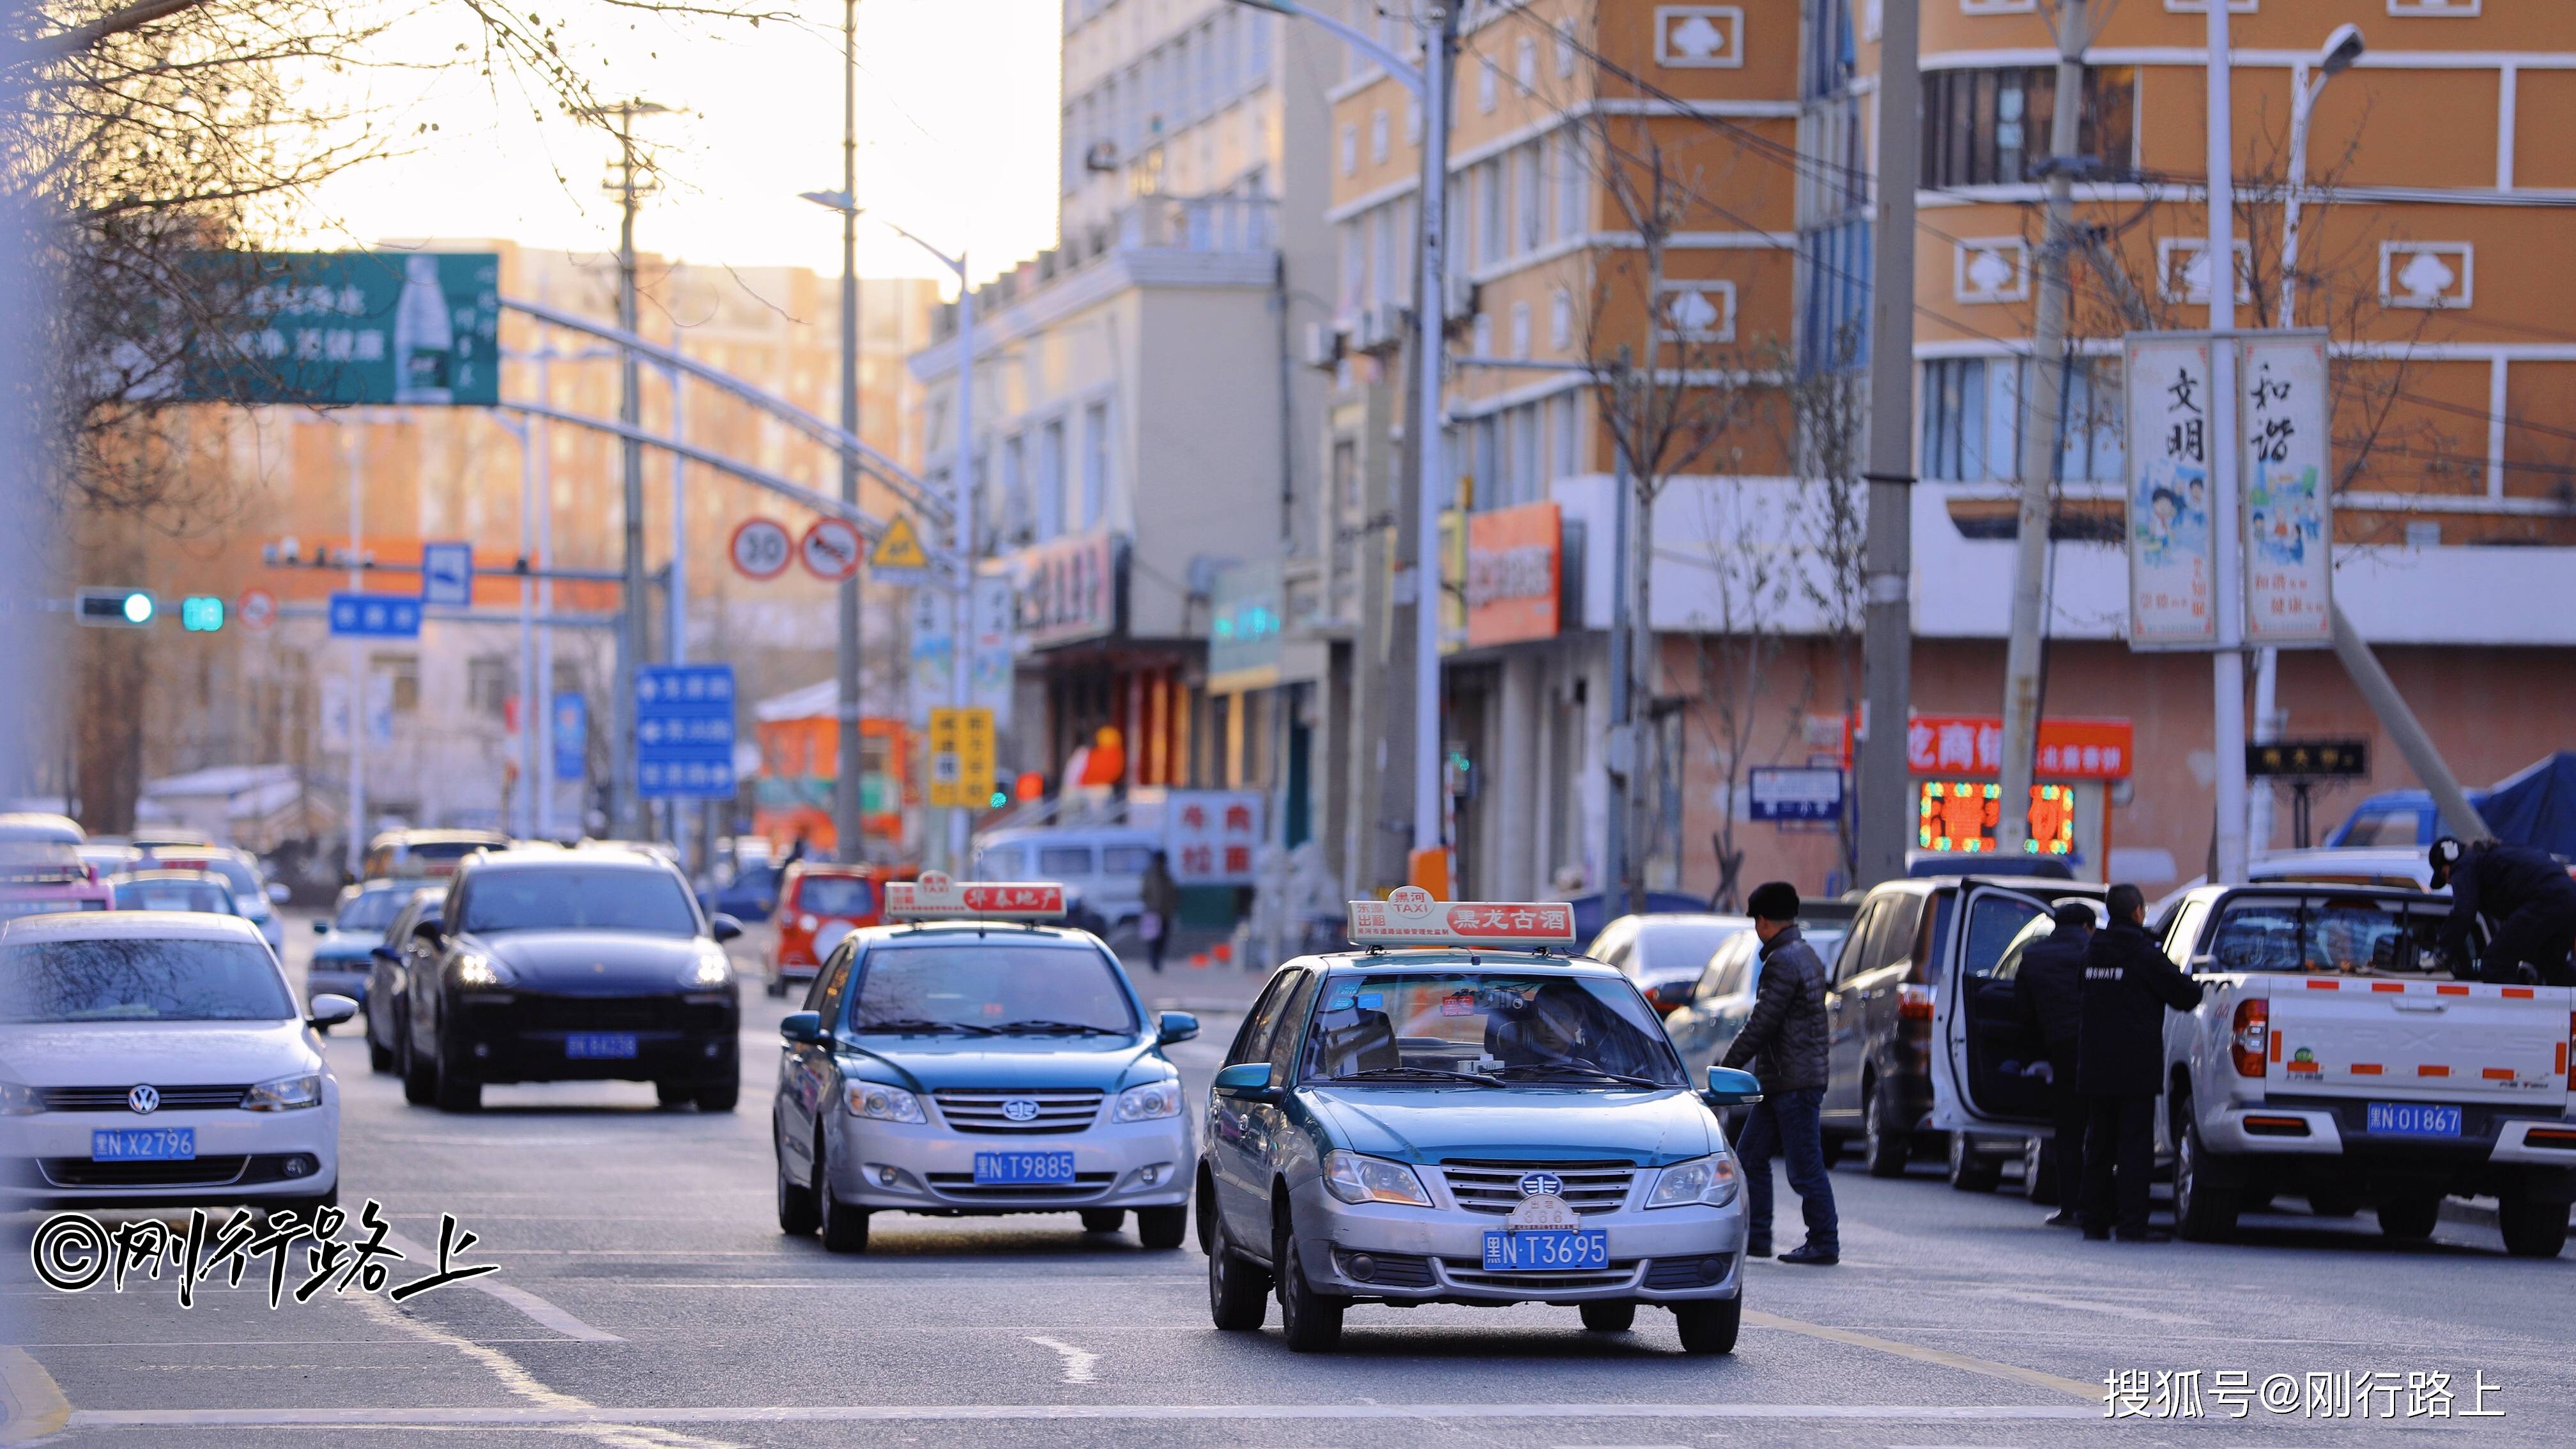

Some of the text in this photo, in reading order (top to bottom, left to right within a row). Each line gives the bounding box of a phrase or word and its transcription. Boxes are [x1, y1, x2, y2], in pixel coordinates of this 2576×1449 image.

[2166, 368, 2205, 463] 文明
[2250, 361, 2295, 463] 和谐
[1395, 892, 1425, 903] 黑河
[1393, 904, 1428, 913] TAXI
[1359, 914, 1386, 926] 出租
[1453, 908, 1567, 931] 黑龙古酒
